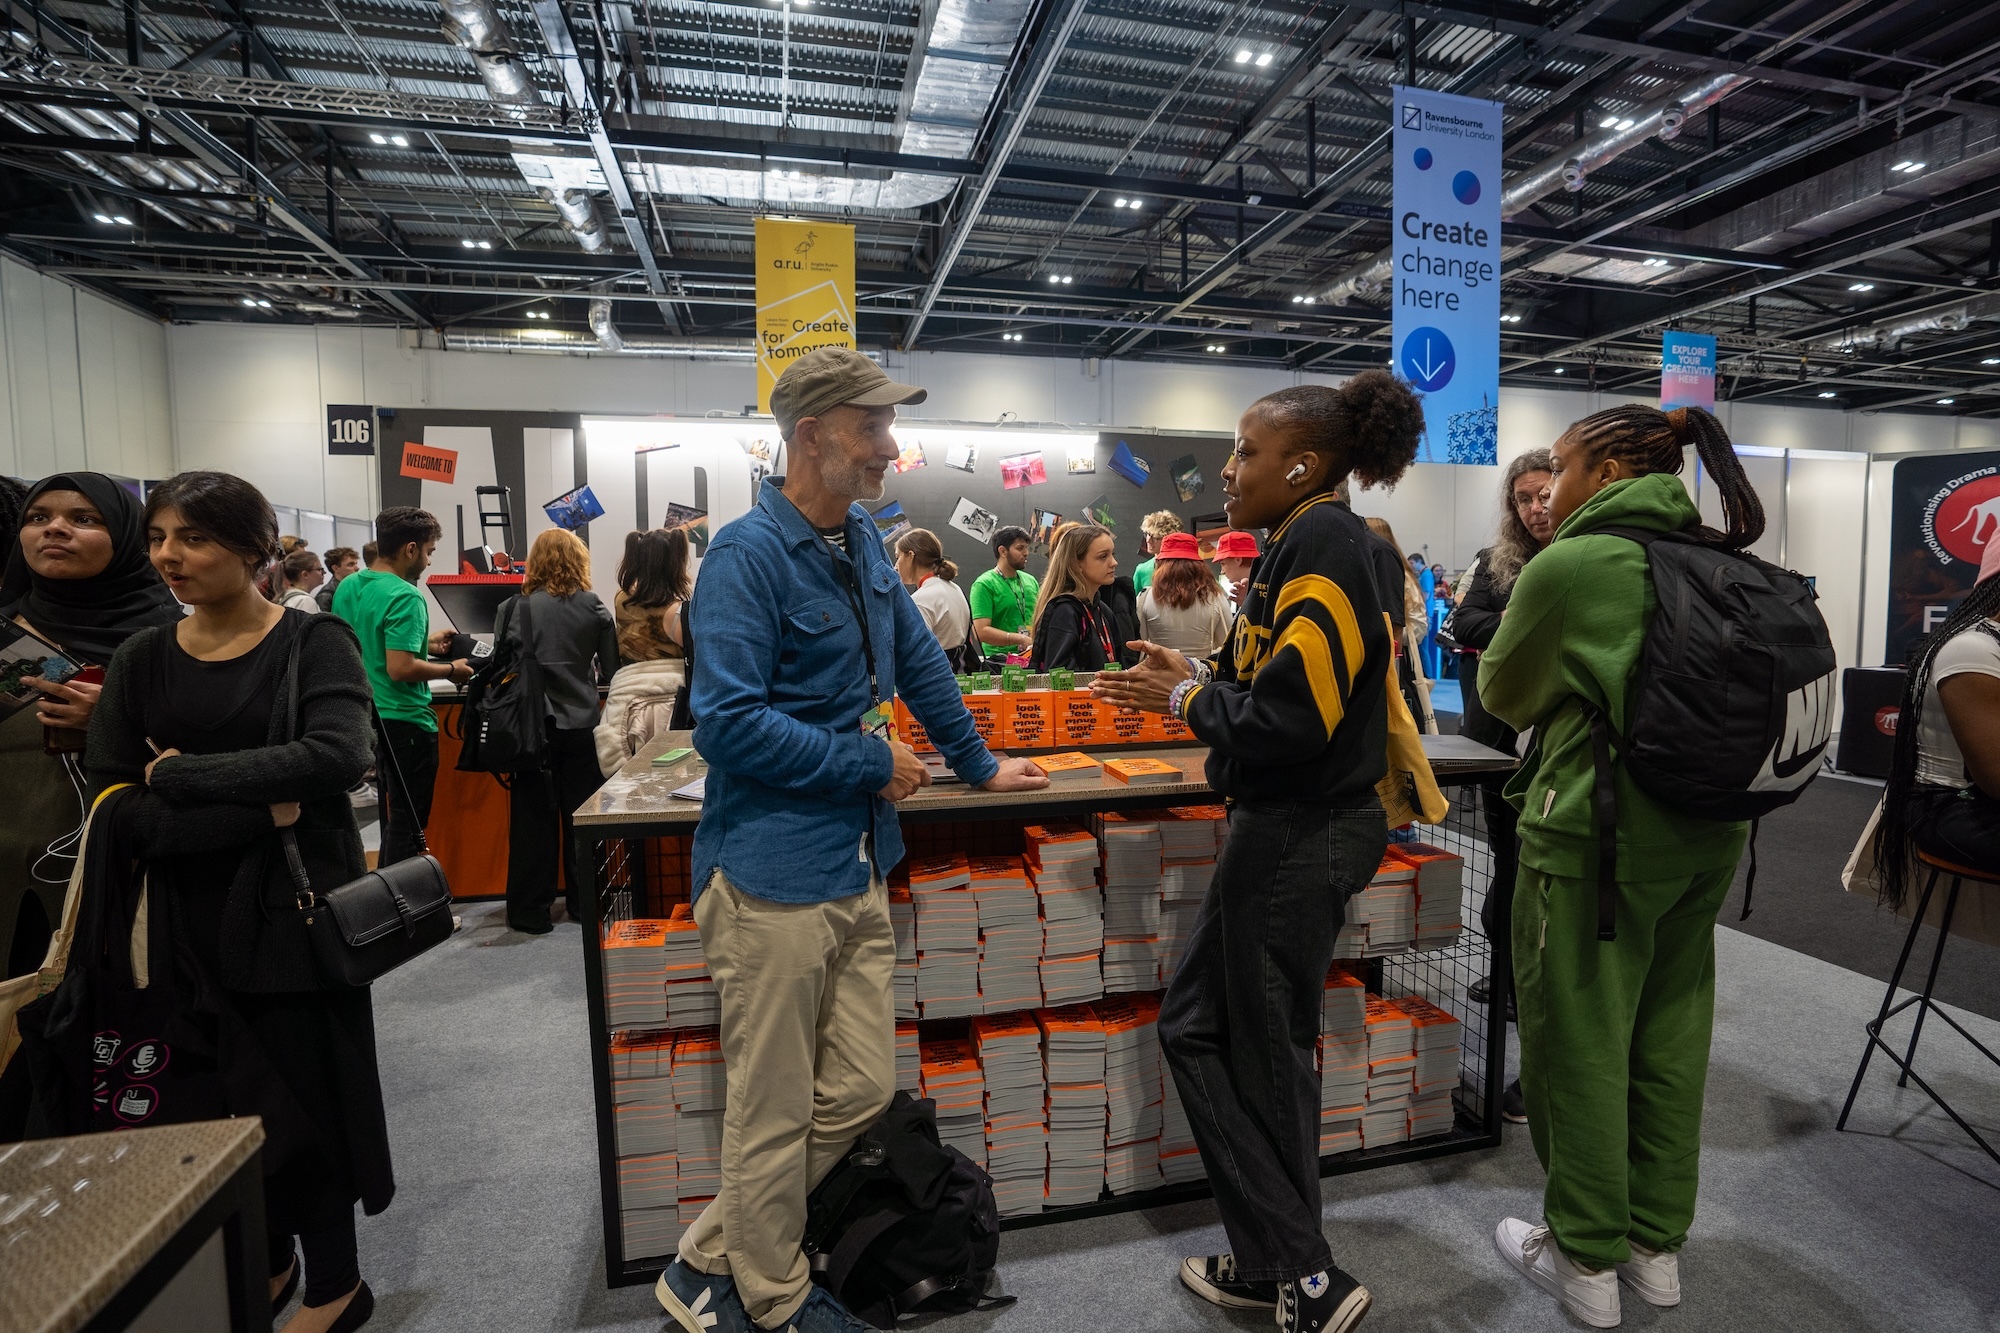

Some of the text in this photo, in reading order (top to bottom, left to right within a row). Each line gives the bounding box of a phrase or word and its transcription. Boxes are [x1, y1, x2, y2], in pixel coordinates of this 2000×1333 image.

[1425, 111, 1484, 129] Ravensbourne
[1425, 122, 1495, 141] University London
[1401, 211, 1489, 248] Create
[773, 259, 804, 270] a.r.u.
[1401, 246, 1494, 288] change
[1401, 278, 1460, 311] here
[792, 319, 849, 333] Create
[762, 330, 785, 343] for
[767, 341, 849, 359] tomorw
[1672, 345, 1708, 357] EXPLORE
[1678, 355, 1701, 366] YOUR
[1665, 364, 1712, 375] CREATIVITY
[1678, 375, 1699, 384] HERE
[331, 418, 370, 444] 106
[405, 451, 453, 475] WELCOME TO
[1920, 466, 1997, 565] Revolutionising Drama
[1016, 704, 1041, 712] look
[1068, 702, 1093, 710] look
[1015, 726, 1043, 734] work
